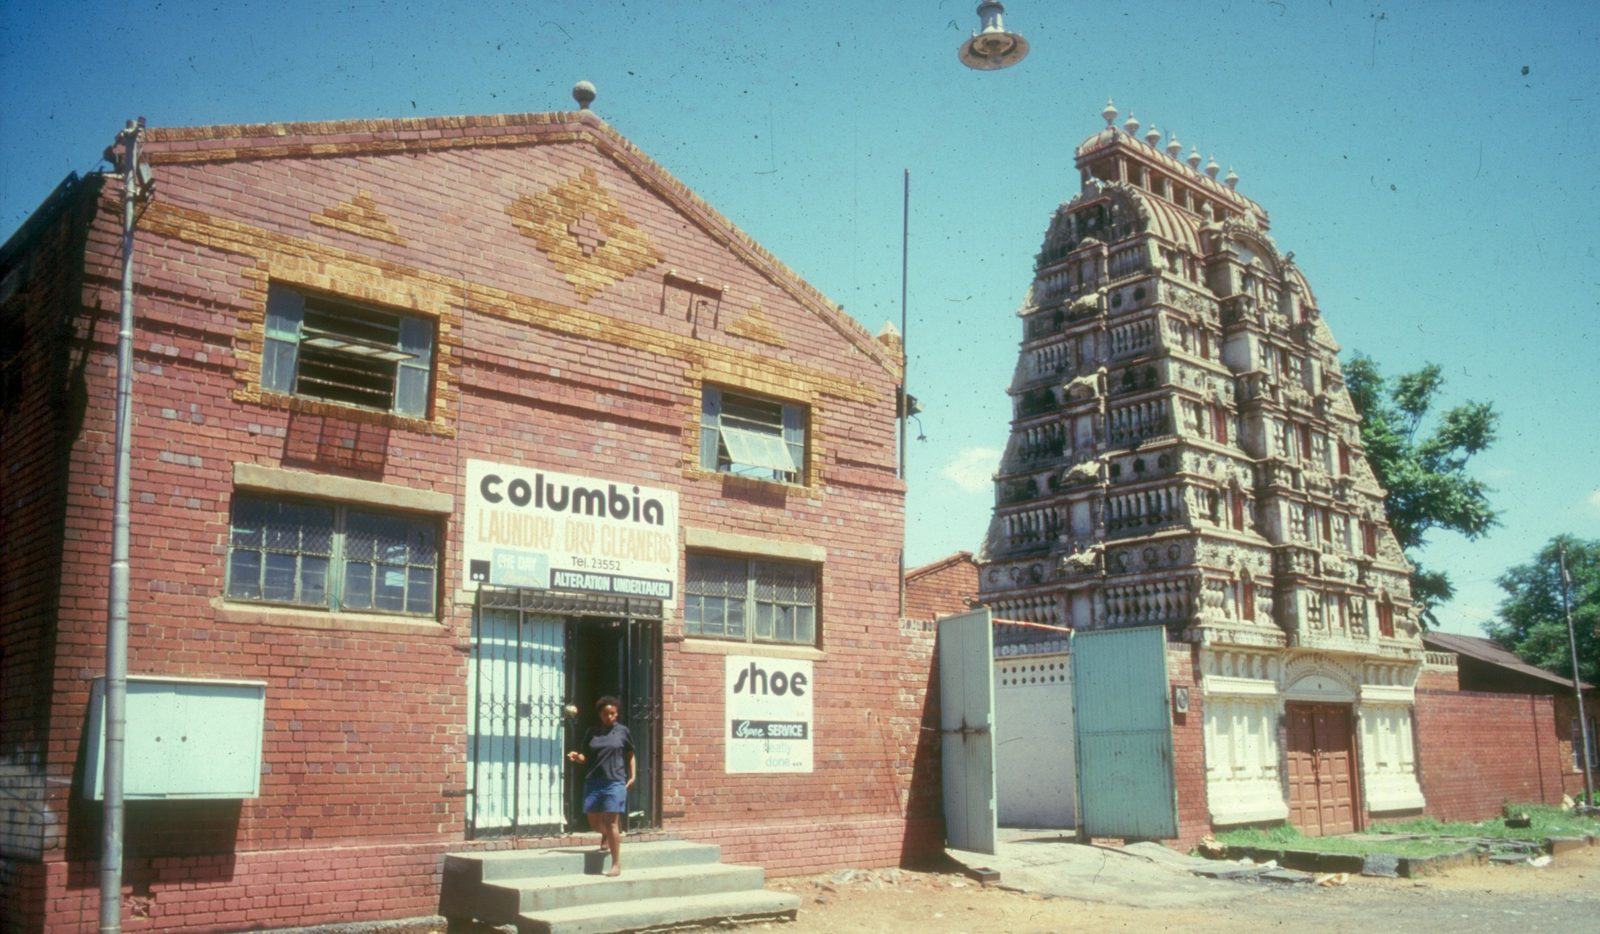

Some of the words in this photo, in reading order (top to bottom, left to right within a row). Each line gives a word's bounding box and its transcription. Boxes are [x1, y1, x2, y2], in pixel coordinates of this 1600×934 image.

[480, 473, 664, 526] columbia
[565, 519, 595, 554] DRY
[601, 523, 672, 564] CLEANERS
[592, 558, 621, 571] 23552
[554, 571, 610, 592] ALTERATION
[613, 576, 671, 597] UNDERTAKEN
[733, 662, 808, 697] shoe
[767, 724, 803, 737] SERVICE
